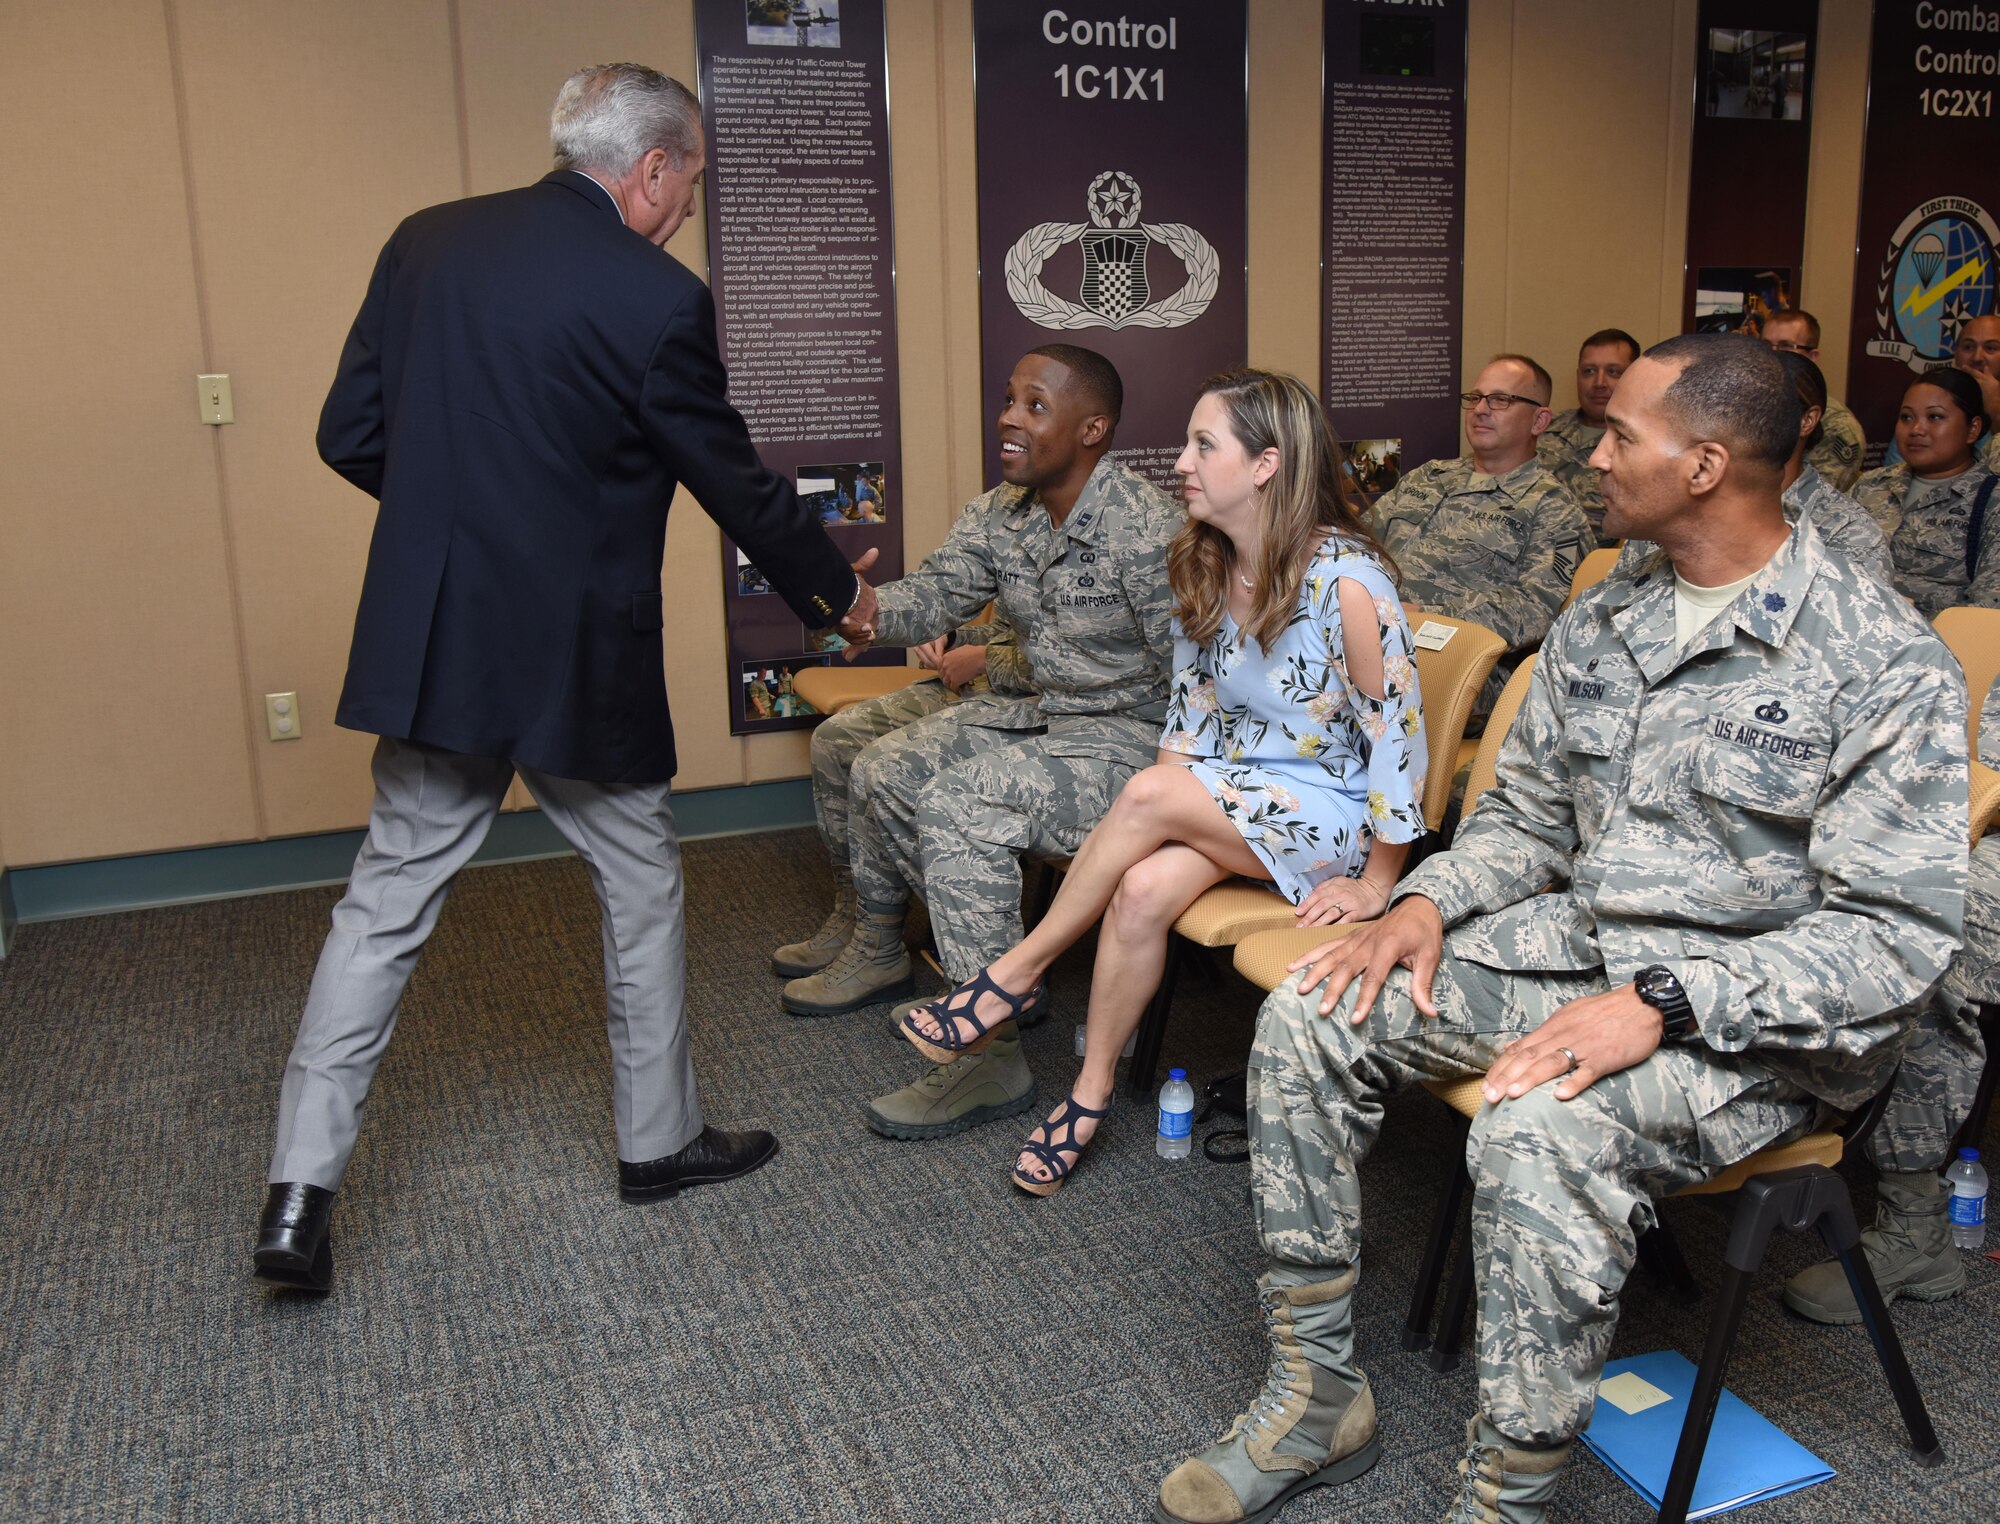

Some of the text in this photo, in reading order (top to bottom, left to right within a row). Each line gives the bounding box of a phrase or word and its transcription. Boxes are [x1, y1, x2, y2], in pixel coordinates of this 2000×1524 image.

[1916, 1, 2000, 32] Comba
[1042, 11, 1177, 50] Control
[713, 55, 726, 63] The
[728, 56, 774, 66] responsibility
[796, 58, 817, 66] Traffic
[818, 59, 844, 67] Control
[845, 60, 866, 68] Tower
[1915, 45, 2000, 76] Control
[713, 65, 750, 75] operations
[768, 67, 795, 77] provide
[796, 68, 808, 76] the
[826, 69, 839, 77] and
[714, 75, 731, 83] tious
[732, 76, 747, 84] flow
[756, 77, 782, 85] aircraft
[783, 78, 792, 87] by
[793, 78, 833, 88] maintaining
[835, 79, 870, 89] separation
[1054, 64, 1165, 101] 1C1X1
[714, 95, 726, 103] the
[727, 96, 756, 104] terminal
[780, 97, 801, 105] There
[815, 98, 833, 106] three
[835, 99, 865, 108] positions
[1920, 88, 1992, 117] 1C2X1
[747, 106, 754, 114] in
[755, 106, 773, 114] most
[774, 107, 799, 115] control
[829, 108, 845, 116] local
[715, 115, 741, 125] ground
[785, 117, 802, 126] flight
[825, 118, 843, 126] Each
[844, 119, 870, 128] position
[1920, 199, 1981, 218] FIRST THERE
[776, 254, 805, 263] provides
[764, 263, 792, 271] vehicles
[793, 263, 826, 272] operating
[850, 263, 872, 272] airport
[723, 273, 757, 282] excluding
[842, 273, 863, 282] safety
[723, 283, 749, 292] ground
[750, 283, 787, 292] operations
[788, 283, 816, 292] requires
[817, 282, 842, 291] precise
[844, 282, 857, 290] and
[726, 331, 746, 340] Flight
[770, 331, 796, 340] primary
[797, 331, 825, 339] purpose
[842, 331, 869, 339] manage
[871, 329, 881, 337] the
[742, 350, 767, 359] ground
[795, 349, 808, 357] and
[810, 349, 835, 357] outside
[836, 348, 866, 358] agencies
[727, 360, 747, 369] using
[748, 359, 781, 367] inter/intra
[782, 359, 804, 368] facility
[1108, 448, 1145, 458] sponsible
[1140, 458, 1159, 466] traffic
[1151, 469, 1168, 477] They
[1488, 513, 1501, 523] AIR
[1501, 516, 1526, 532] FORCE
[997, 570, 1019, 585] RATT
[1060, 594, 1120, 608] U.S. AIR FORCE
[1568, 680, 1605, 701] WILSON
[1735, 726, 1759, 747] AIR
[1760, 733, 1814, 761] FORCE
